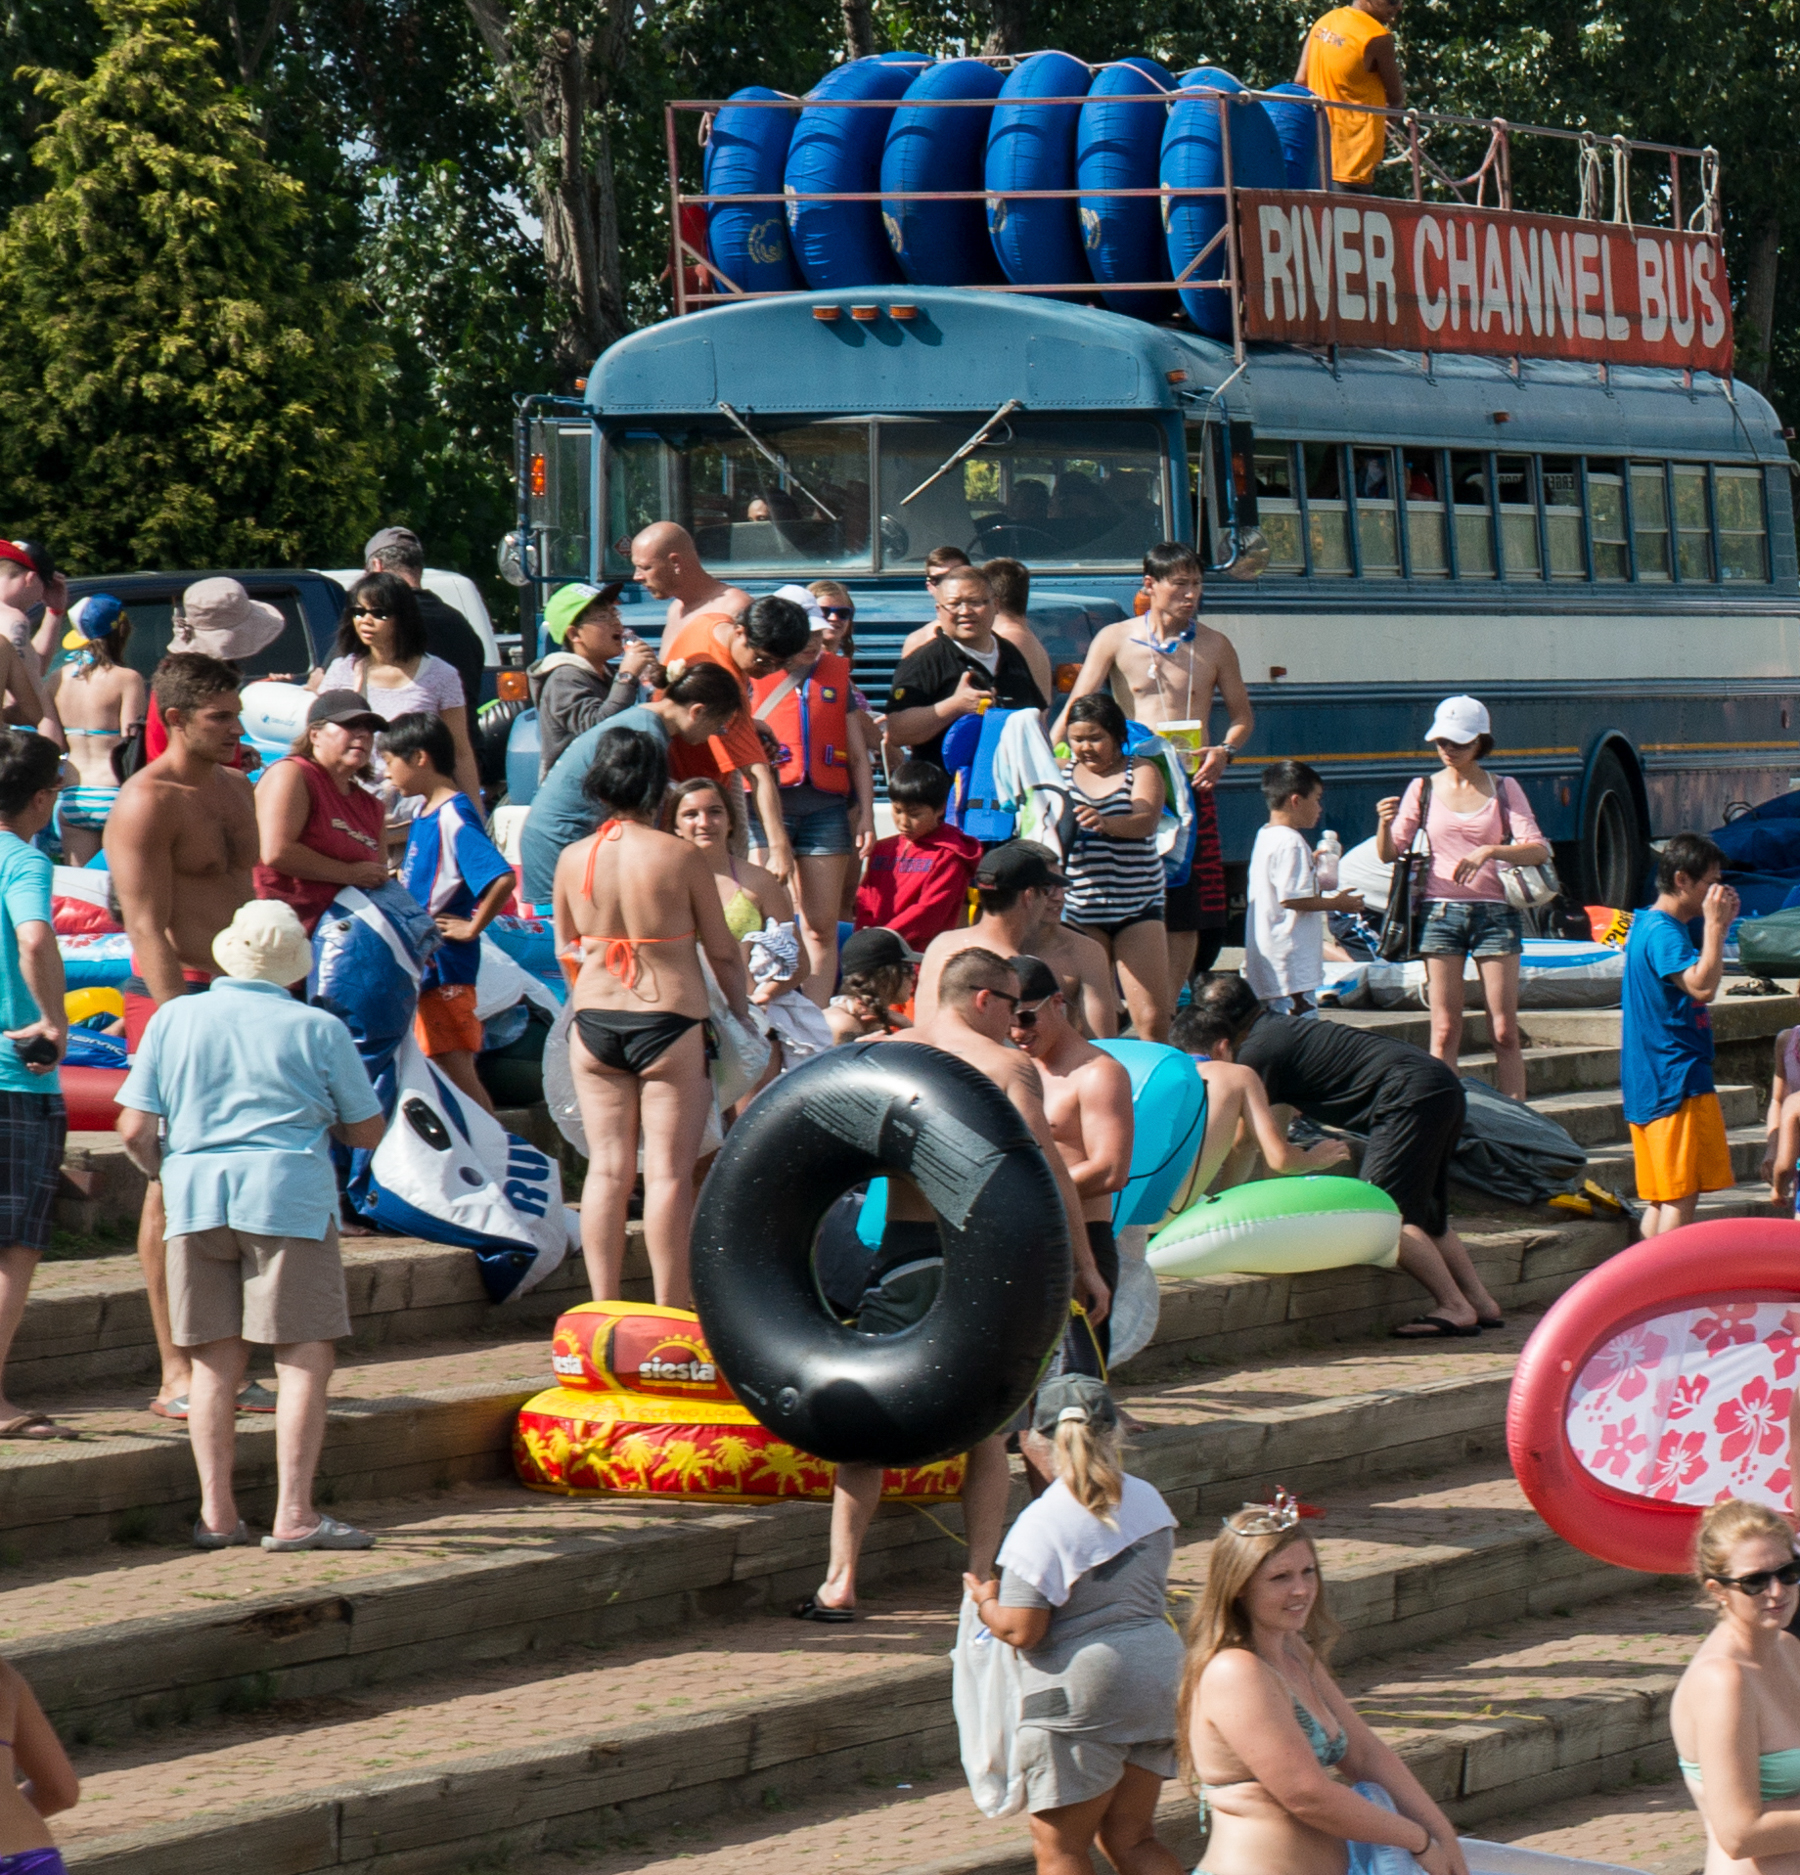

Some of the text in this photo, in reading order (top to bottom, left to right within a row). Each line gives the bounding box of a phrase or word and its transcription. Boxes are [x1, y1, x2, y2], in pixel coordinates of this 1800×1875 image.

[1258, 204, 1726, 348] RIVER CHANNEL BUS
[638, 1356, 716, 1381] siesta
